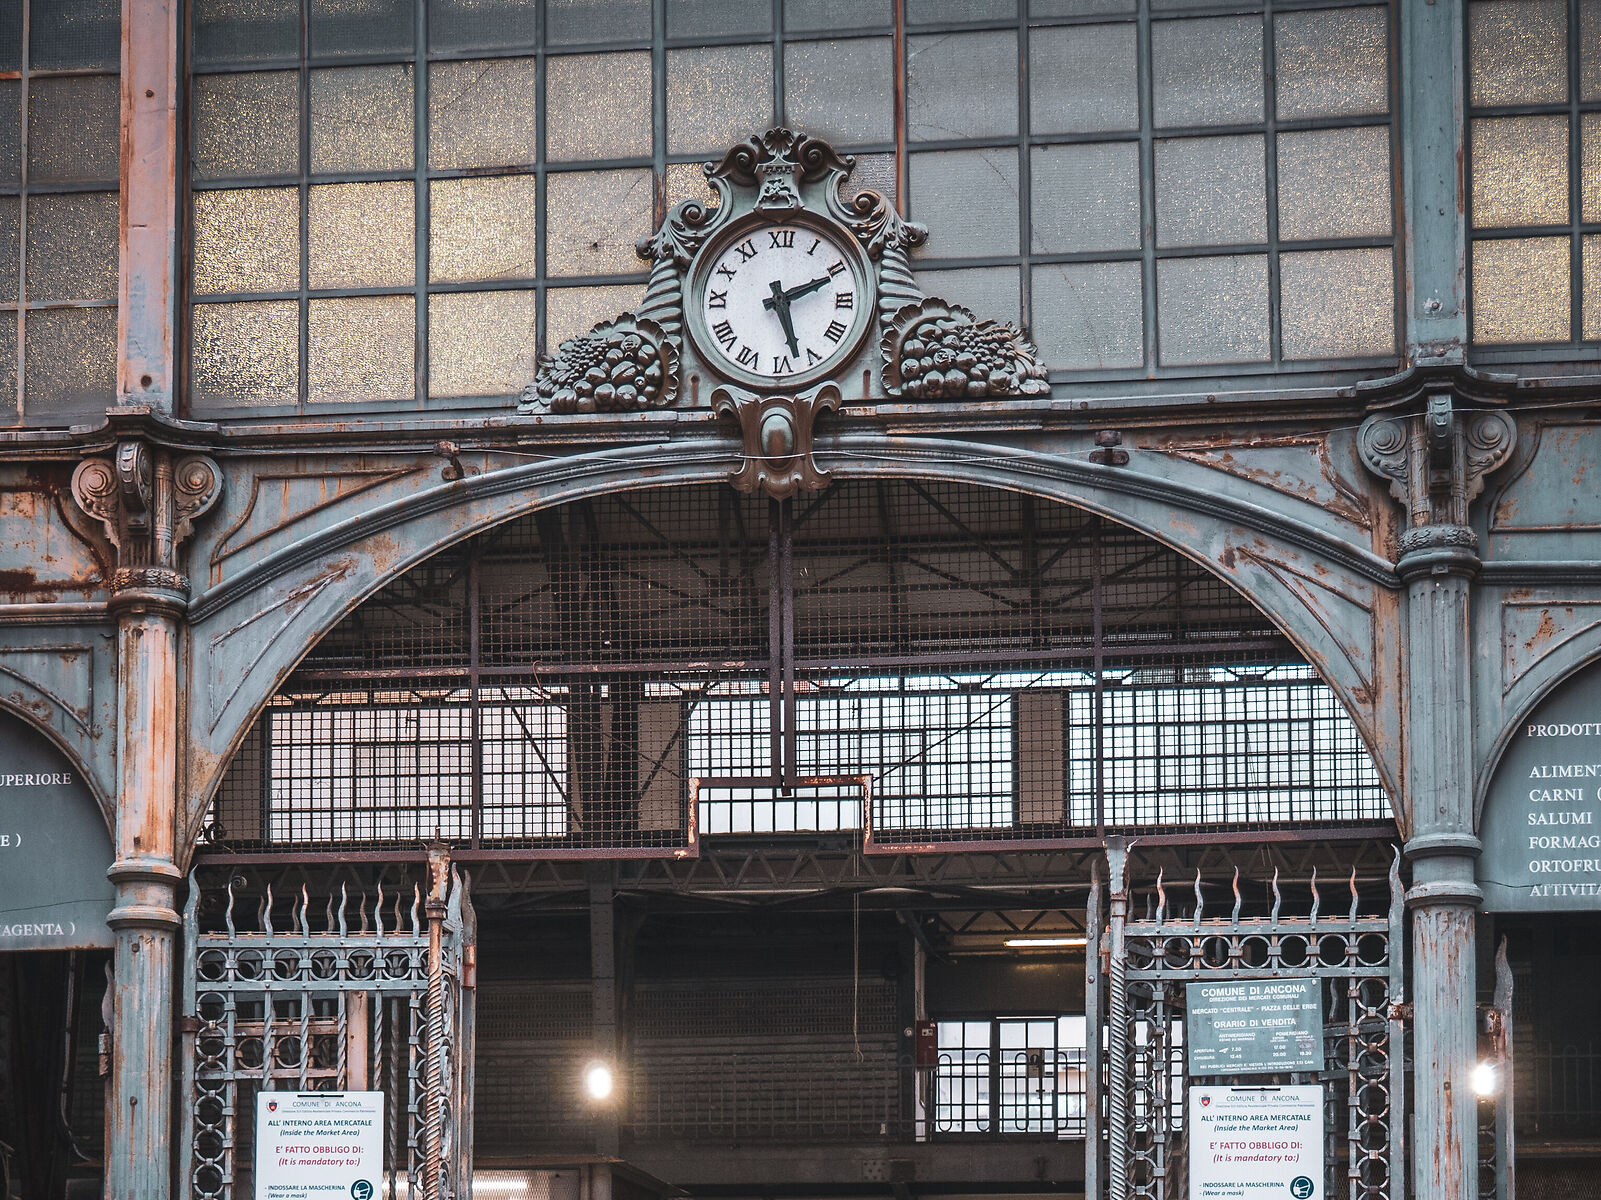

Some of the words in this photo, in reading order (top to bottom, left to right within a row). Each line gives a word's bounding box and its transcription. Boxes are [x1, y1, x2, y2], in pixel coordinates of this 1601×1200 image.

[769, 230, 795, 248] XII
[807, 239, 821, 256] I
[735, 239, 758, 263] XI
[716, 263, 737, 282] X
[827, 260, 847, 278] II
[709, 289, 728, 309] IX
[836, 292, 853, 309] III
[712, 320, 738, 352] VIII
[735, 345, 760, 370] VII
[773, 356, 794, 373] VI
[806, 348, 822, 366] V
[1529, 789, 1583, 801] CARNI
[1528, 812, 1592, 825] SALUMI
[0, 923, 64, 937] AGENTA
[1201, 987, 1245, 997] COMUNE
[1250, 986, 1260, 995] DI
[1264, 985, 1306, 994] ANCONA
[278, 1158, 288, 1166] (It
[299, 1158, 343, 1166] mandatory
[346, 1158, 360, 1166] to:)
[1213, 1154, 1224, 1163] (It
[1235, 1154, 1281, 1163] mandatory
[1284, 1154, 1299, 1162] to:)
